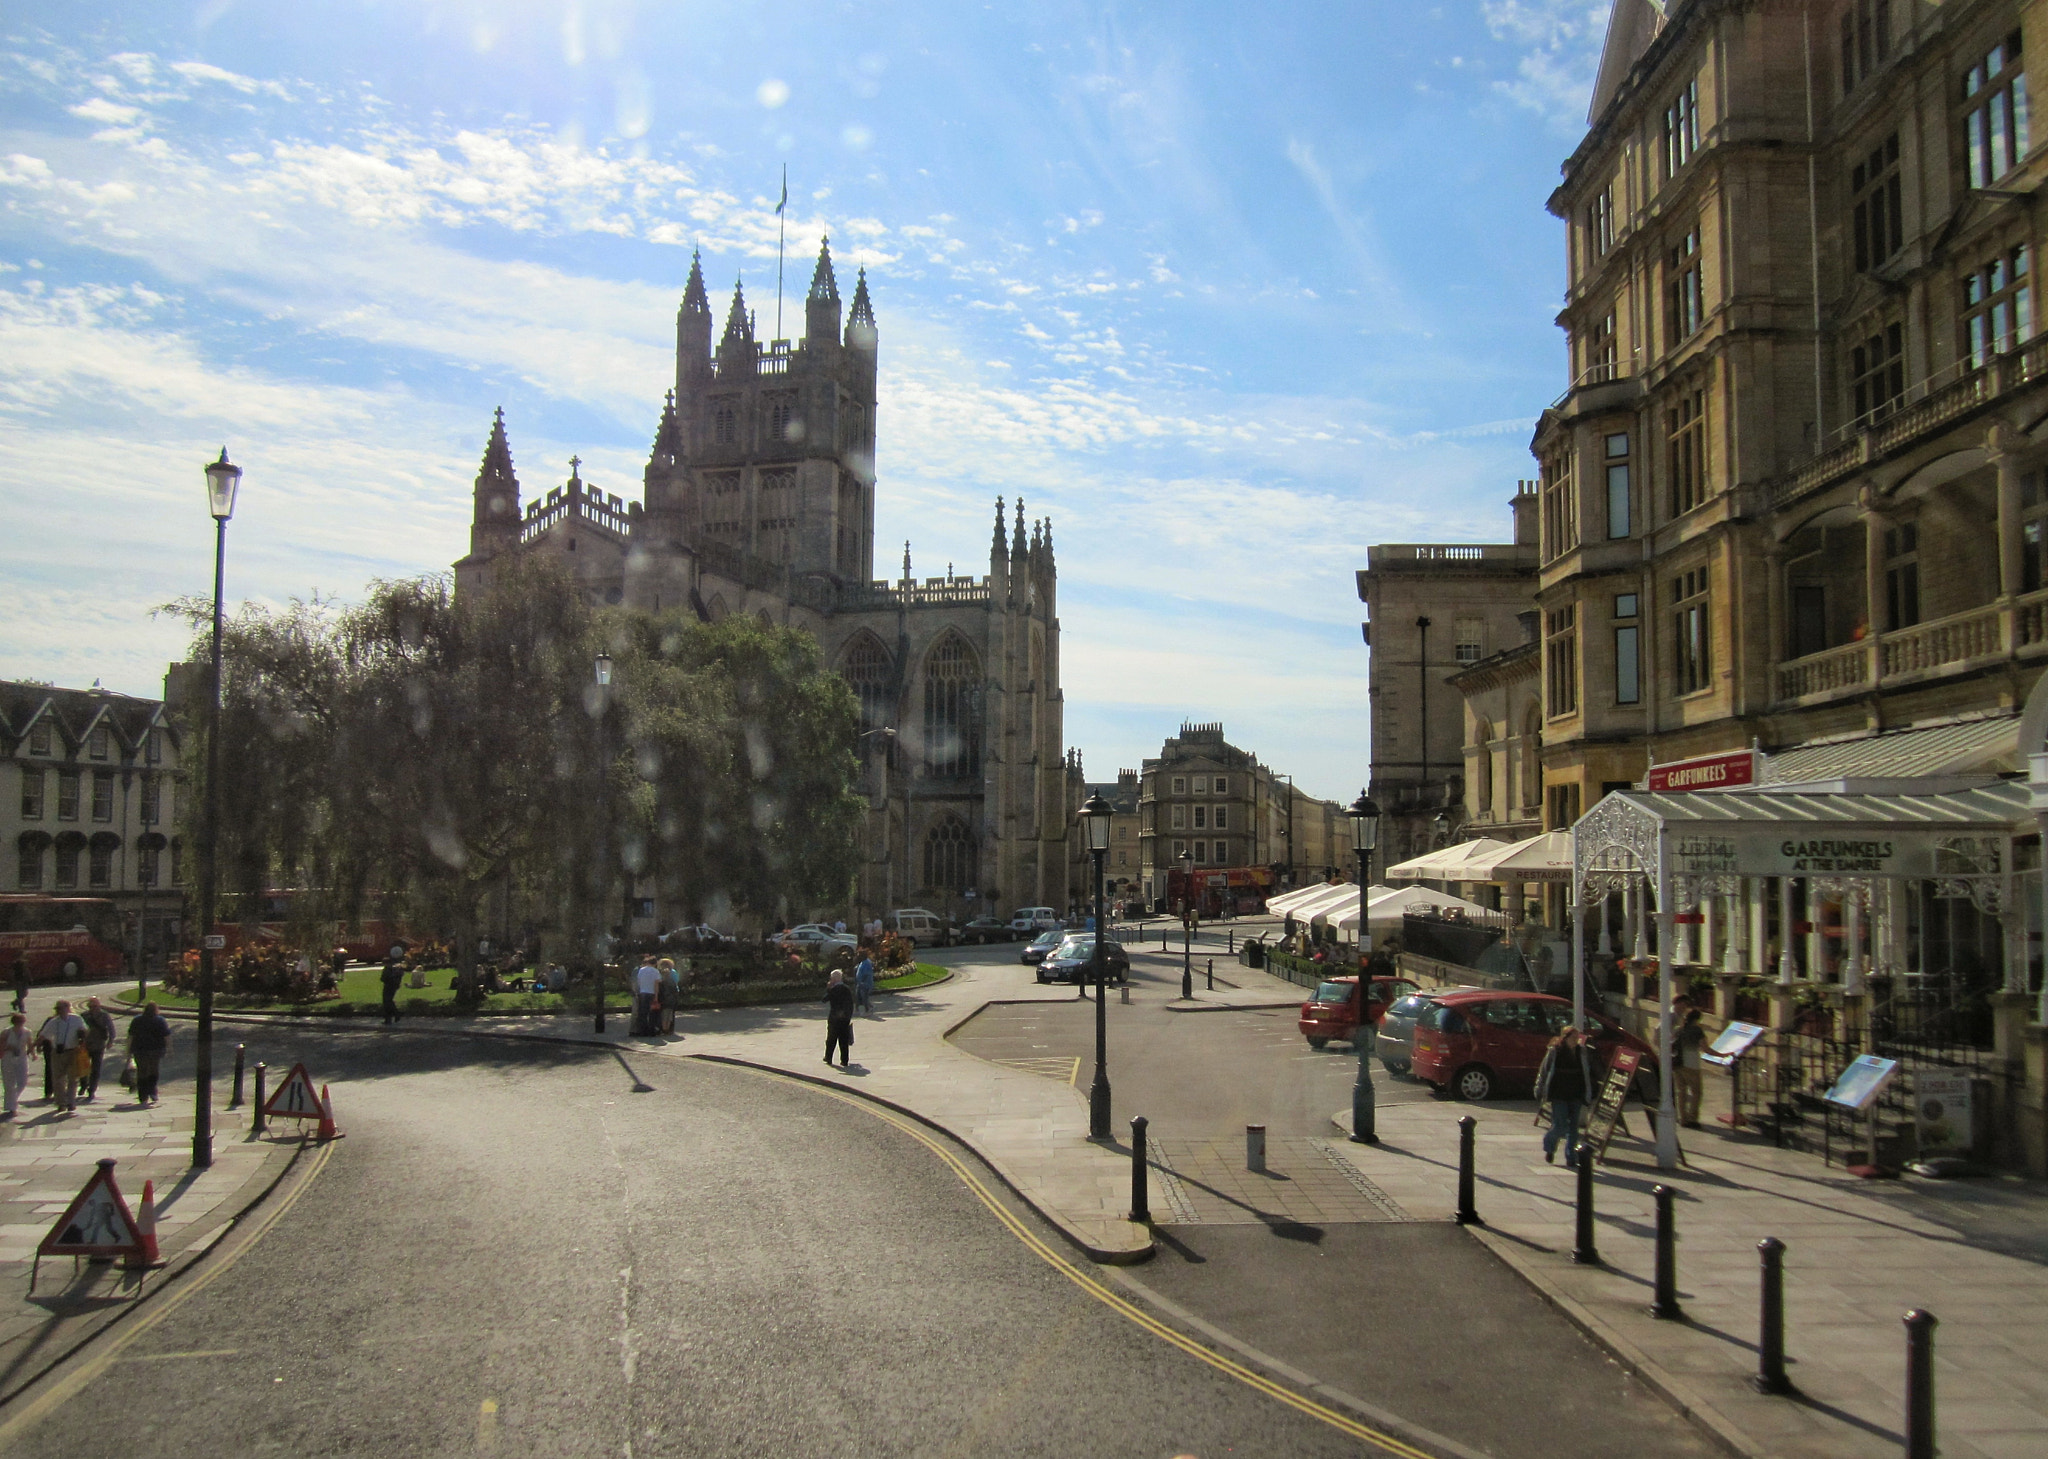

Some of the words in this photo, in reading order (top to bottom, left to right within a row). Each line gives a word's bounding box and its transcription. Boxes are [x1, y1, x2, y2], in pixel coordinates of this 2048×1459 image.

[1781, 840, 1892, 858] GARFUNKELS
[1792, 859, 1807, 870] AT
[1811, 858, 1833, 870] THE
[1837, 859, 1881, 870] EMPIRE
[1516, 870, 1573, 880] RESTAURAN
